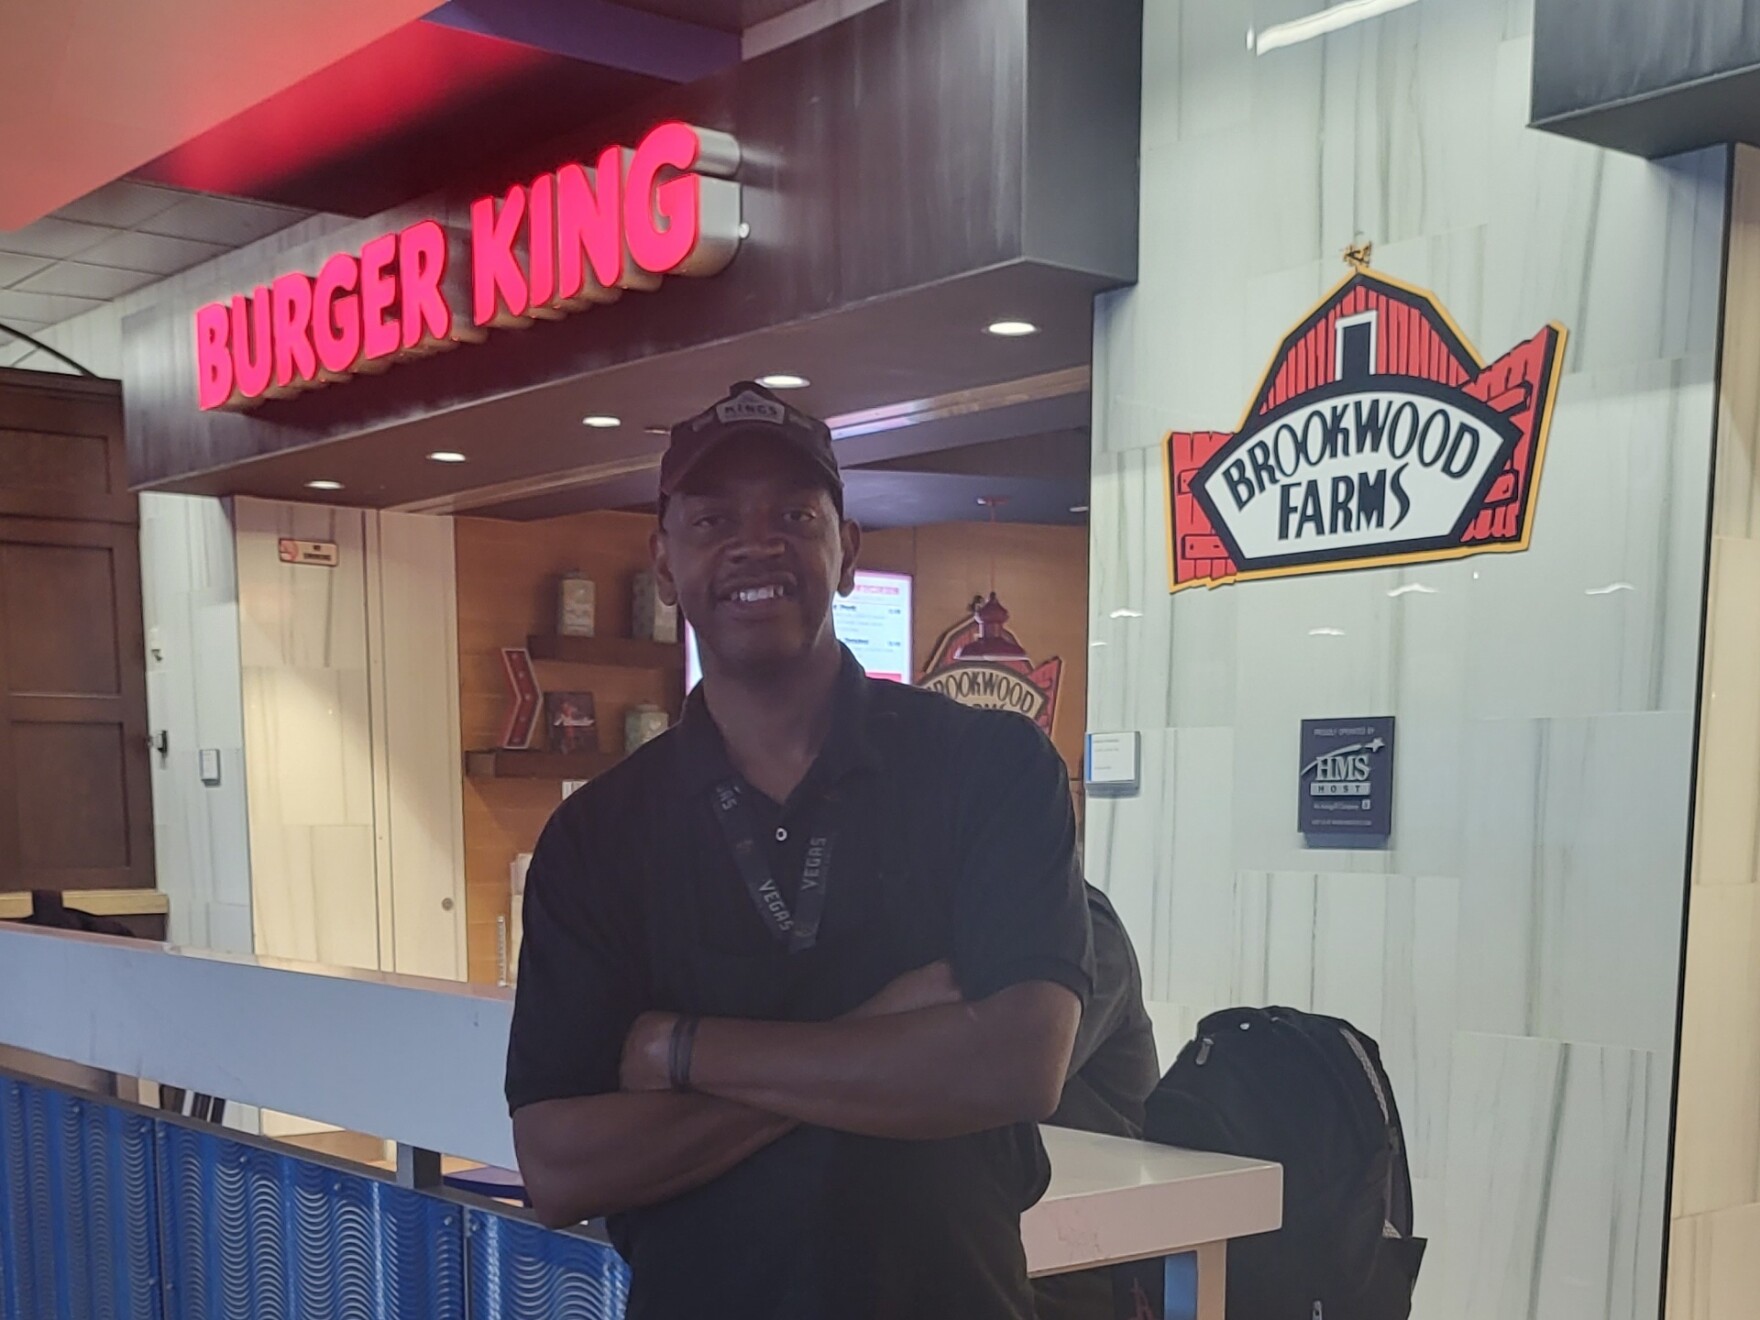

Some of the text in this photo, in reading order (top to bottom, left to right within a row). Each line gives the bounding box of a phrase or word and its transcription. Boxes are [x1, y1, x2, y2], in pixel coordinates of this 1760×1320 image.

[195, 120, 700, 412] BURGER KING
[1222, 398, 1481, 513] BROOKWOOD
[1277, 461, 1411, 541] FARMS
[1316, 753, 1370, 781] HMS
[1317, 784, 1361, 794] HOST
[800, 836, 828, 892] VEGAS
[757, 877, 795, 932] VEGAS
